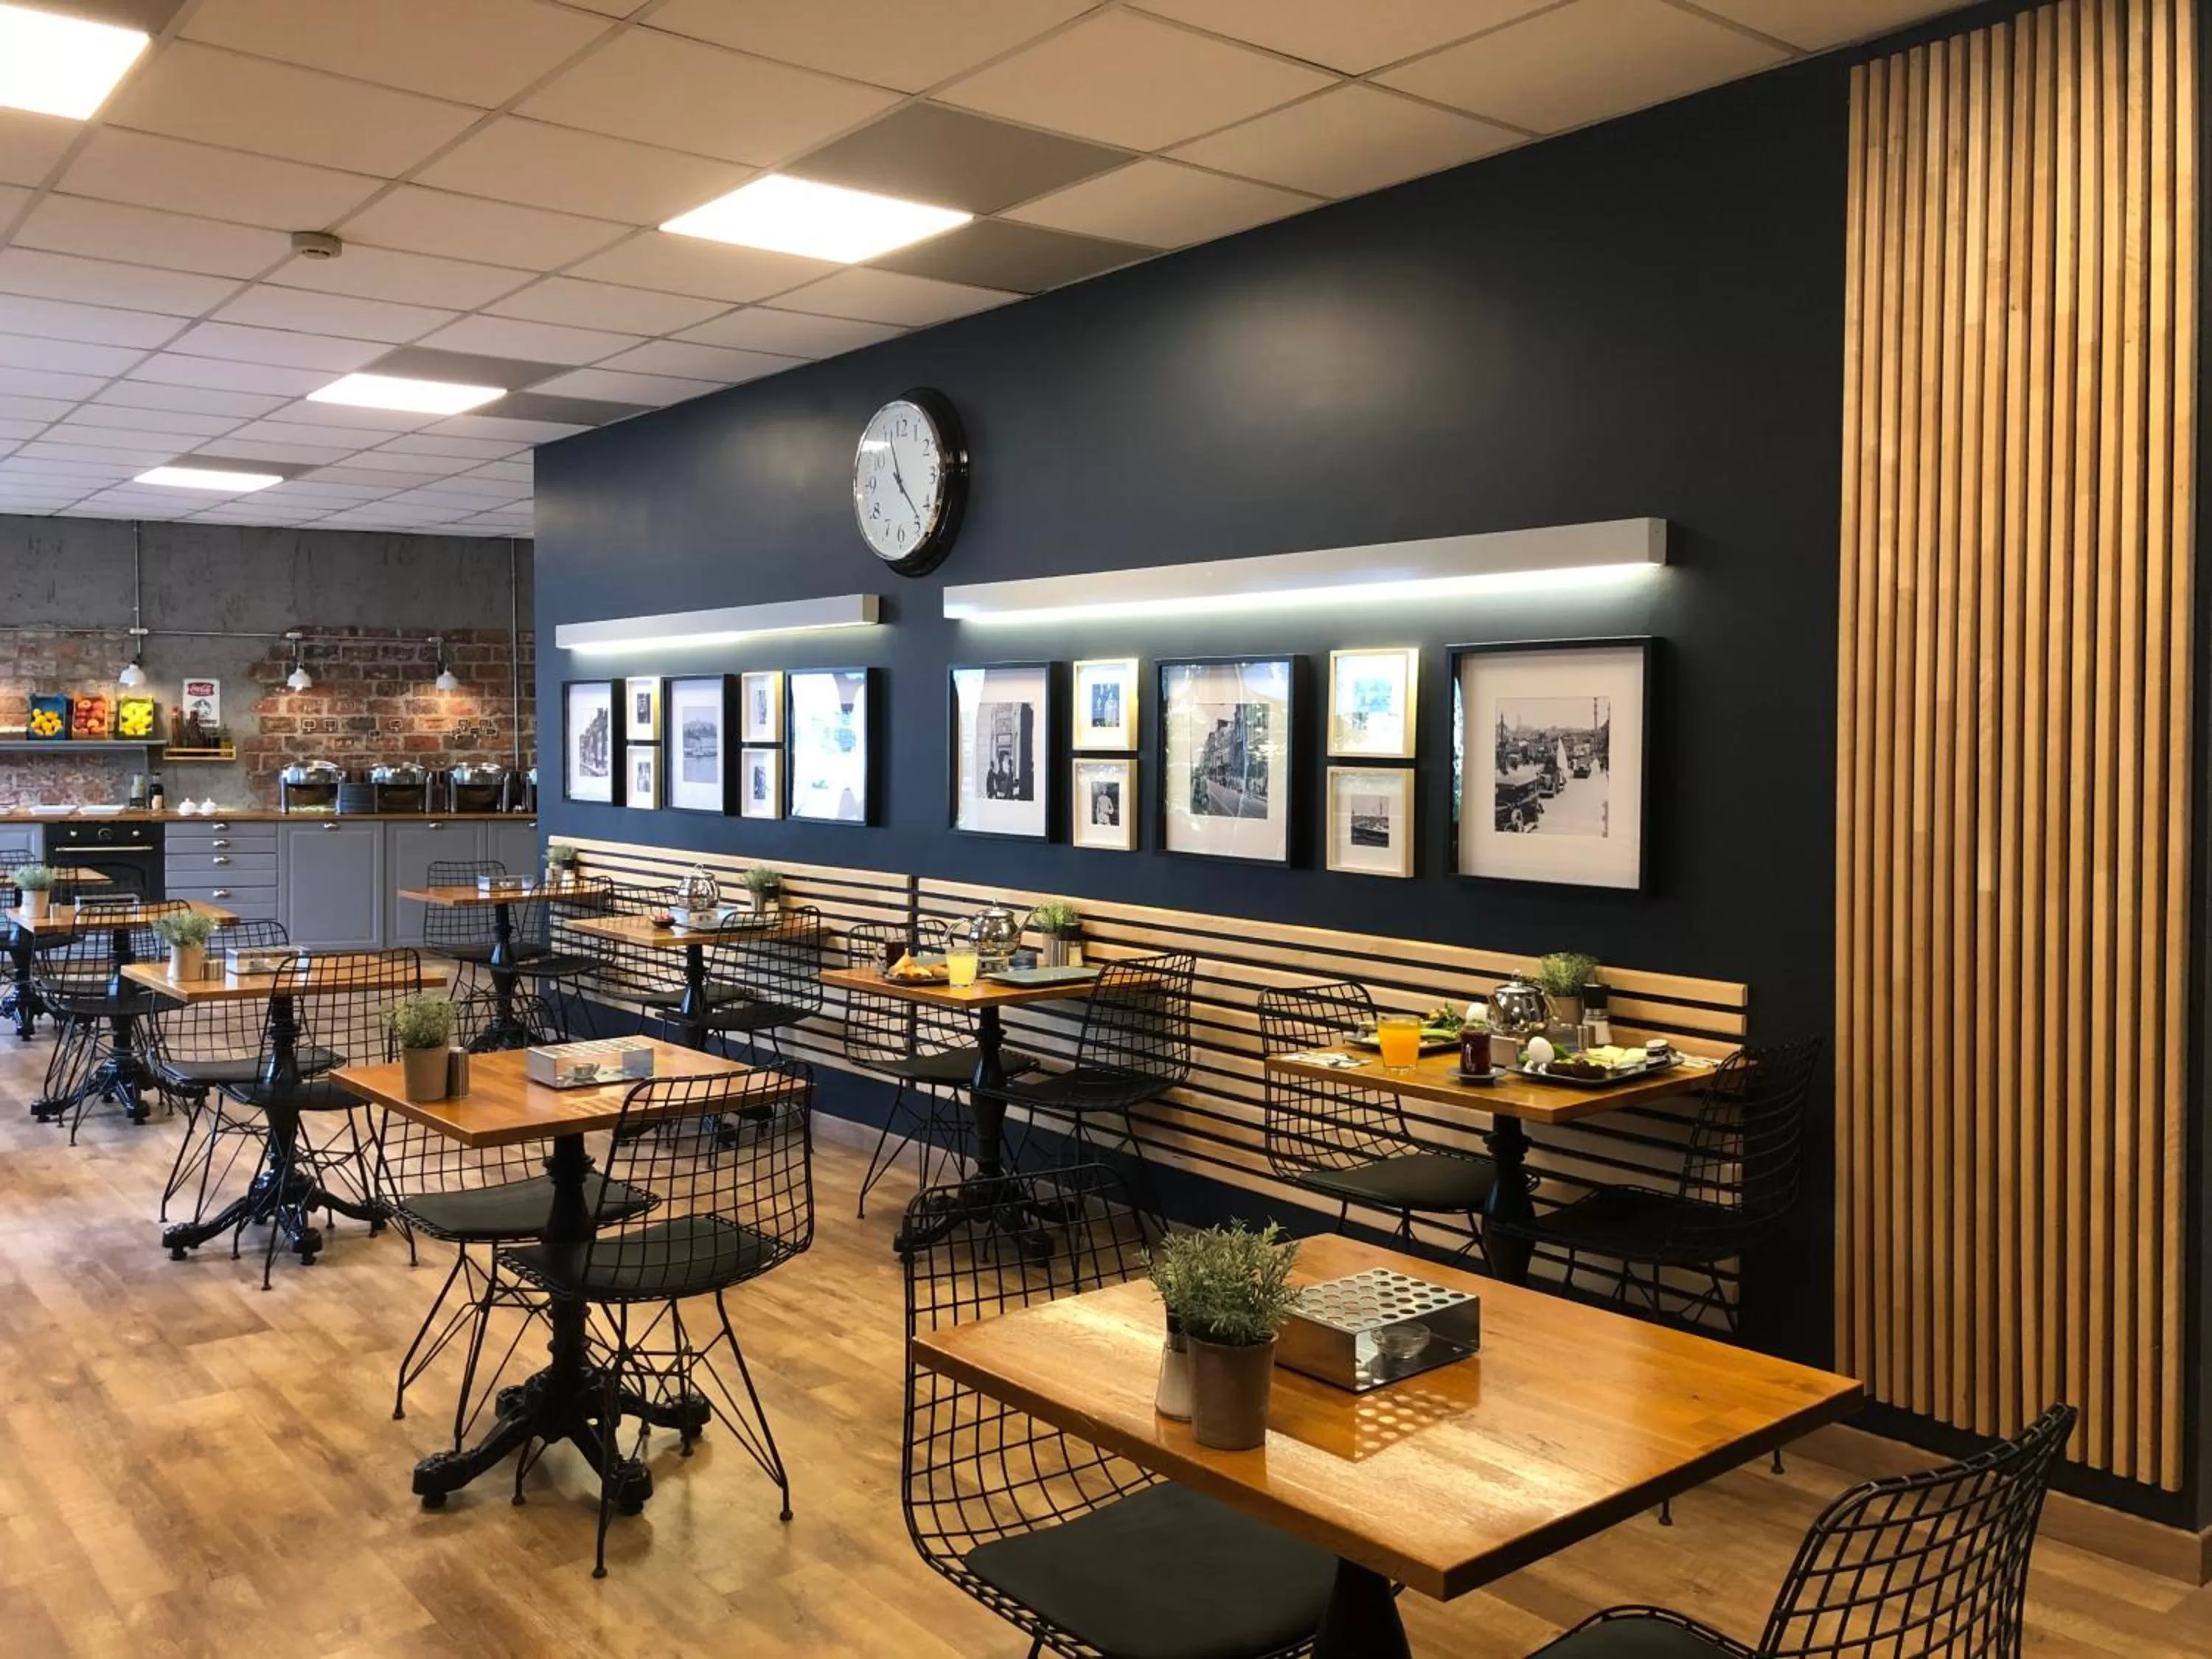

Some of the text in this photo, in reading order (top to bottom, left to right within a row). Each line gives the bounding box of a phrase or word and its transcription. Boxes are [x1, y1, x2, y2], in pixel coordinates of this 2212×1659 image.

[896, 419, 908, 437] 12
[922, 439, 930, 456] 2
[874, 451, 886, 471] 10
[930, 465, 936, 486] 3
[869, 476, 877, 495] 9
[872, 502, 880, 520] 8
[922, 495, 931, 512] 4
[885, 518, 891, 538] 7
[897, 524, 905, 543] 6
